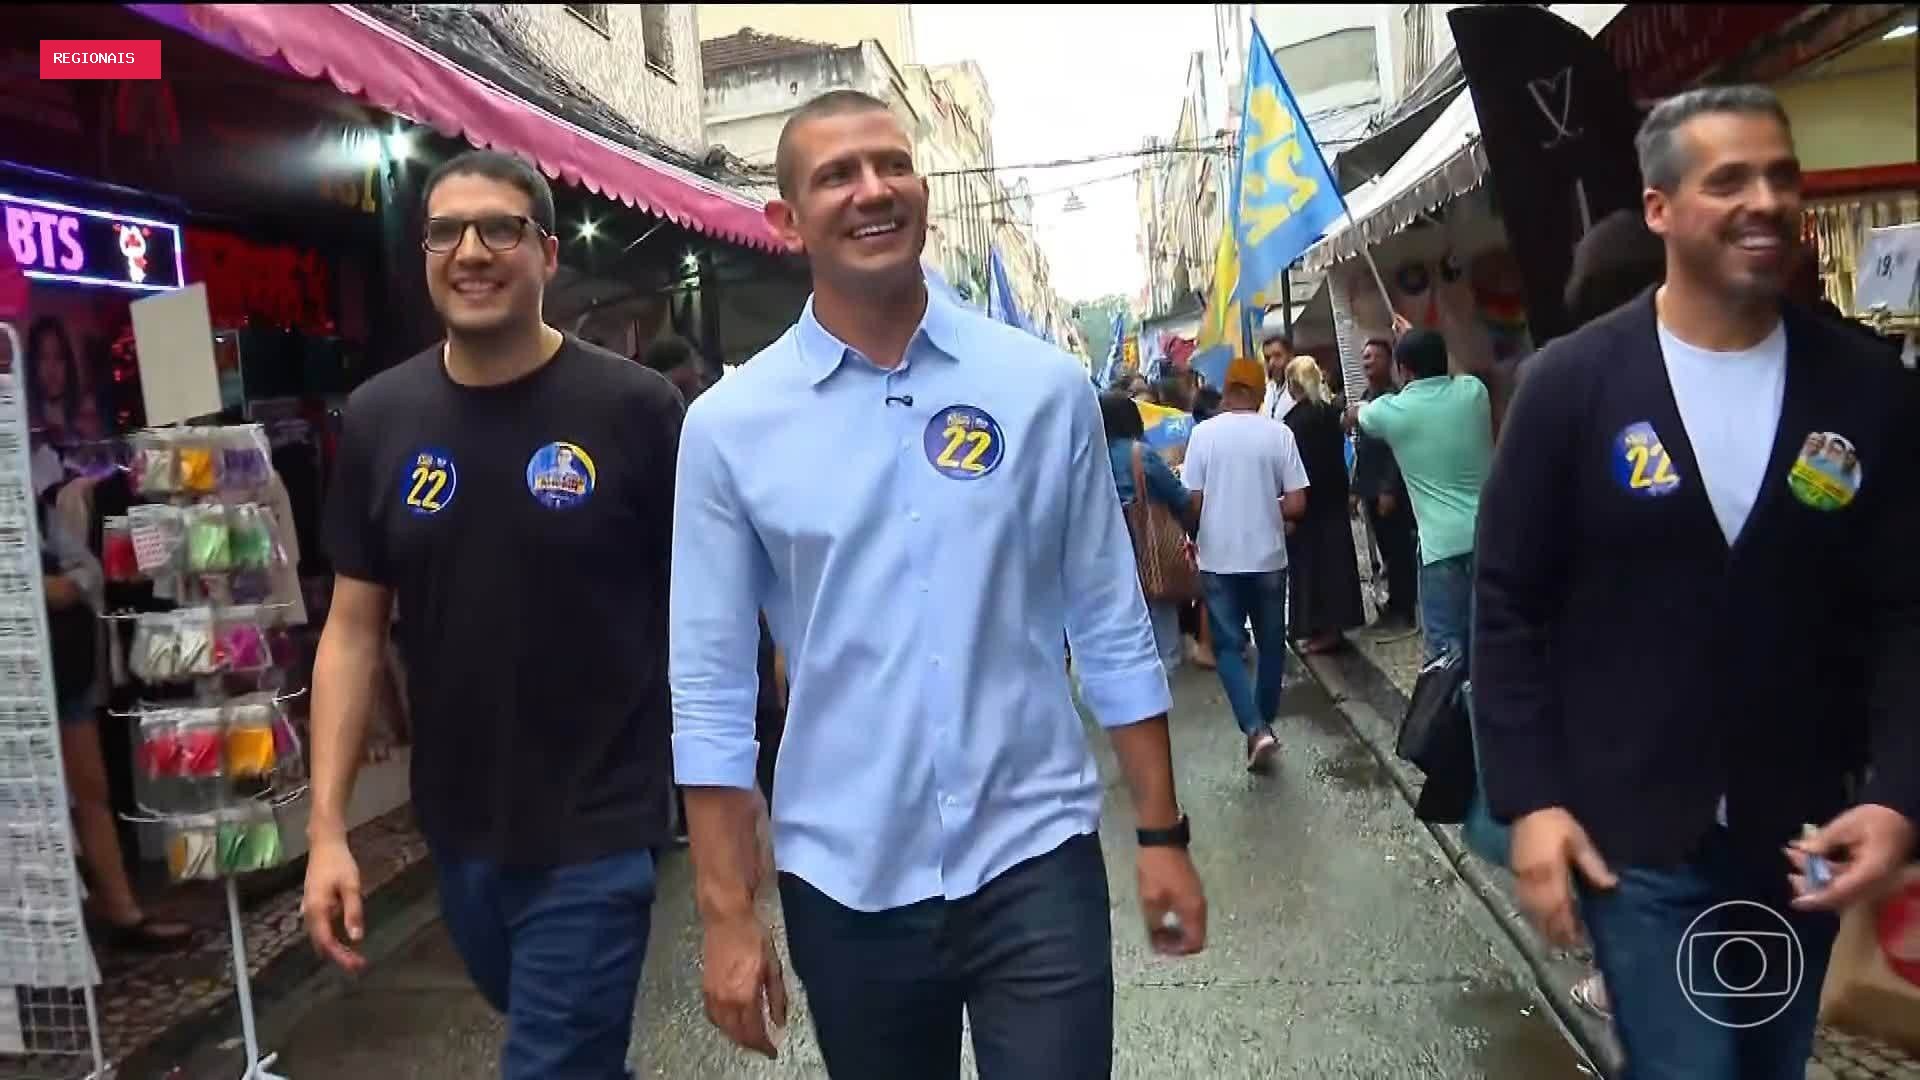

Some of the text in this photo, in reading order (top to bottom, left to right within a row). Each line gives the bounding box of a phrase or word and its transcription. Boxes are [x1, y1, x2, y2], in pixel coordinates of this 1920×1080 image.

[5, 206, 85, 271] BTS
[936, 425, 992, 472] 22
[1625, 445, 1681, 489] 22
[407, 466, 448, 511] 22
